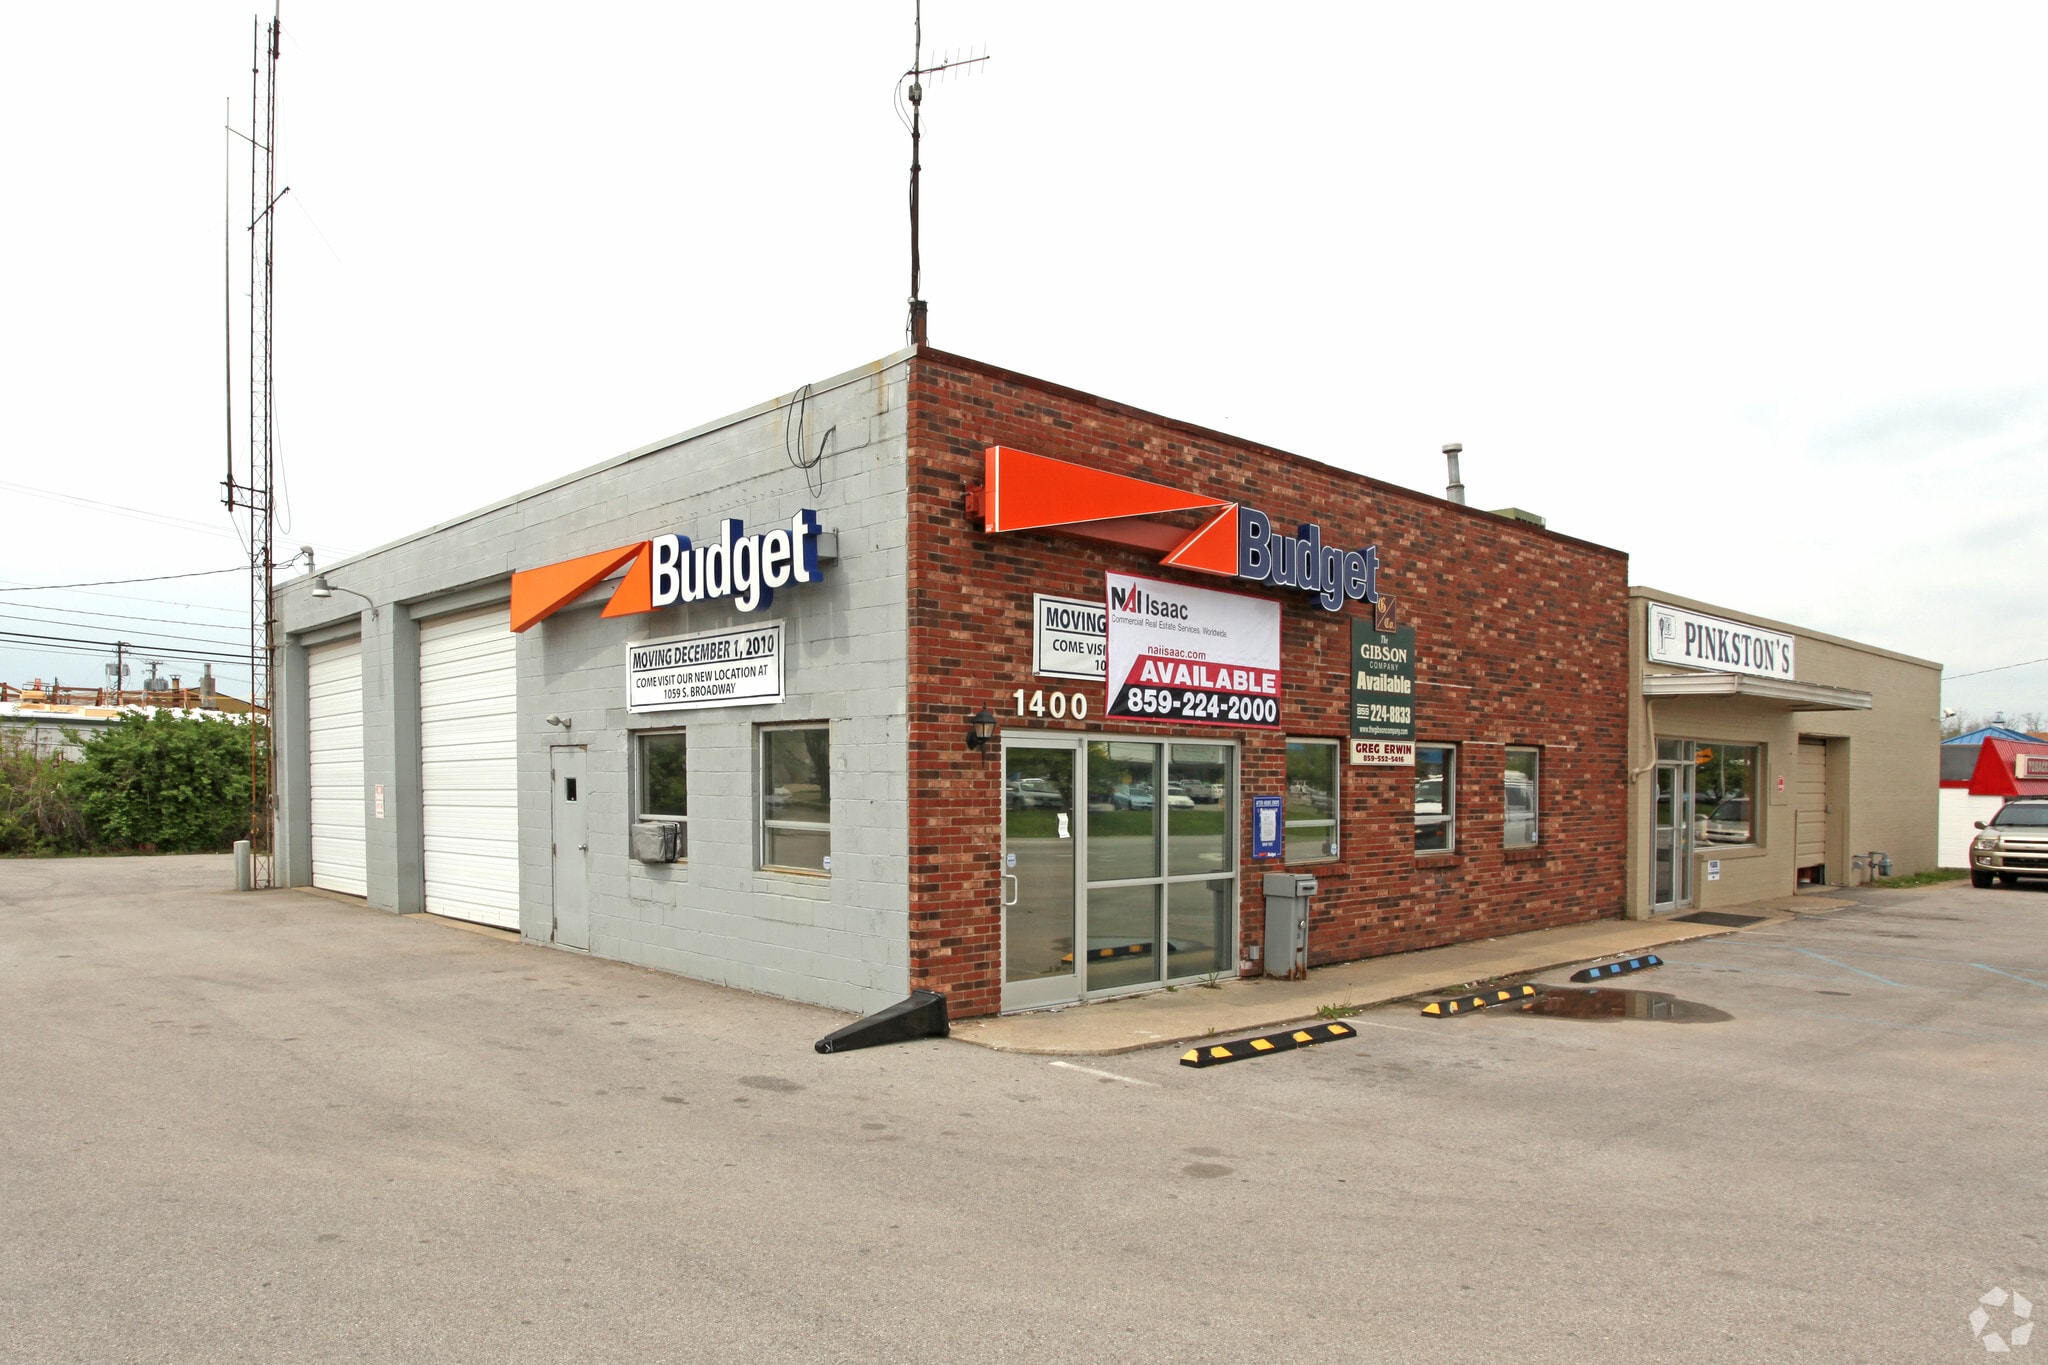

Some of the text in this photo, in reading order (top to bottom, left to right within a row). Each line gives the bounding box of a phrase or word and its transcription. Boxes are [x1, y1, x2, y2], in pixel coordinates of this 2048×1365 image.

[652, 509, 820, 612] Budget
[1240, 506, 1379, 612] Budget
[1112, 582, 1188, 620] NAI Isaac
[1046, 607, 1106, 633] MOVING
[1111, 614, 1144, 627] Commercial
[1145, 619, 1158, 628] Real
[1159, 620, 1176, 631] Estate
[633, 634, 774, 669] MOVING DECEMBER 1, 2010
[1053, 639, 1084, 654] COME
[1381, 635, 1389, 645] The
[1684, 621, 1790, 674] PINKSTON'S
[1147, 645, 1206, 660] naiisaac.com
[1360, 643, 1407, 663] GIBSON
[636, 664, 769, 688] COME VISIT OUR NEW LOCATION AT
[1139, 660, 1276, 693] AVAILABLE
[1369, 661, 1399, 671] COMPANY
[664, 683, 737, 699] 1059 S. BROADWAY
[1356, 671, 1411, 694] Available
[1013, 689, 1087, 720] 1400
[1128, 687, 1277, 722] 859-224-2000
[1357, 704, 1411, 724] 859 224-8833
[1356, 743, 1412, 755] GREG ERWIN
[1363, 755, 1405, 763] 859-552-5416
